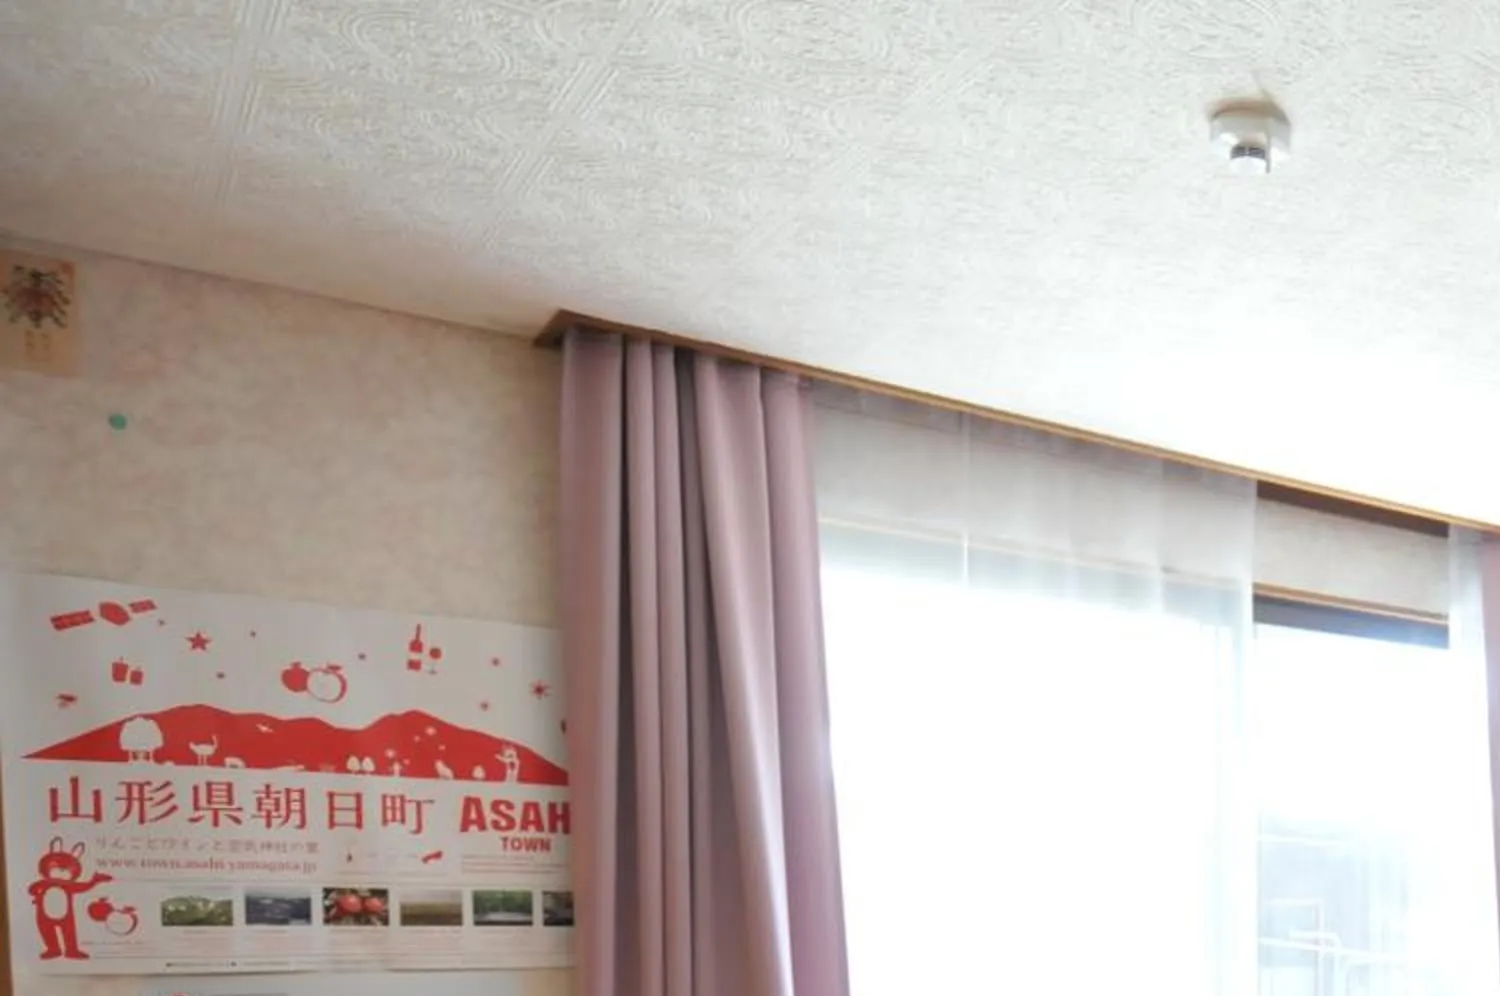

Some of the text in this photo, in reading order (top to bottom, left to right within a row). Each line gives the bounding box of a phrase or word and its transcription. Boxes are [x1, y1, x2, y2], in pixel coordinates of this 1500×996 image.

[49, 776, 435, 835] 山形県朝日町
[500, 836, 552, 853] TOWN
